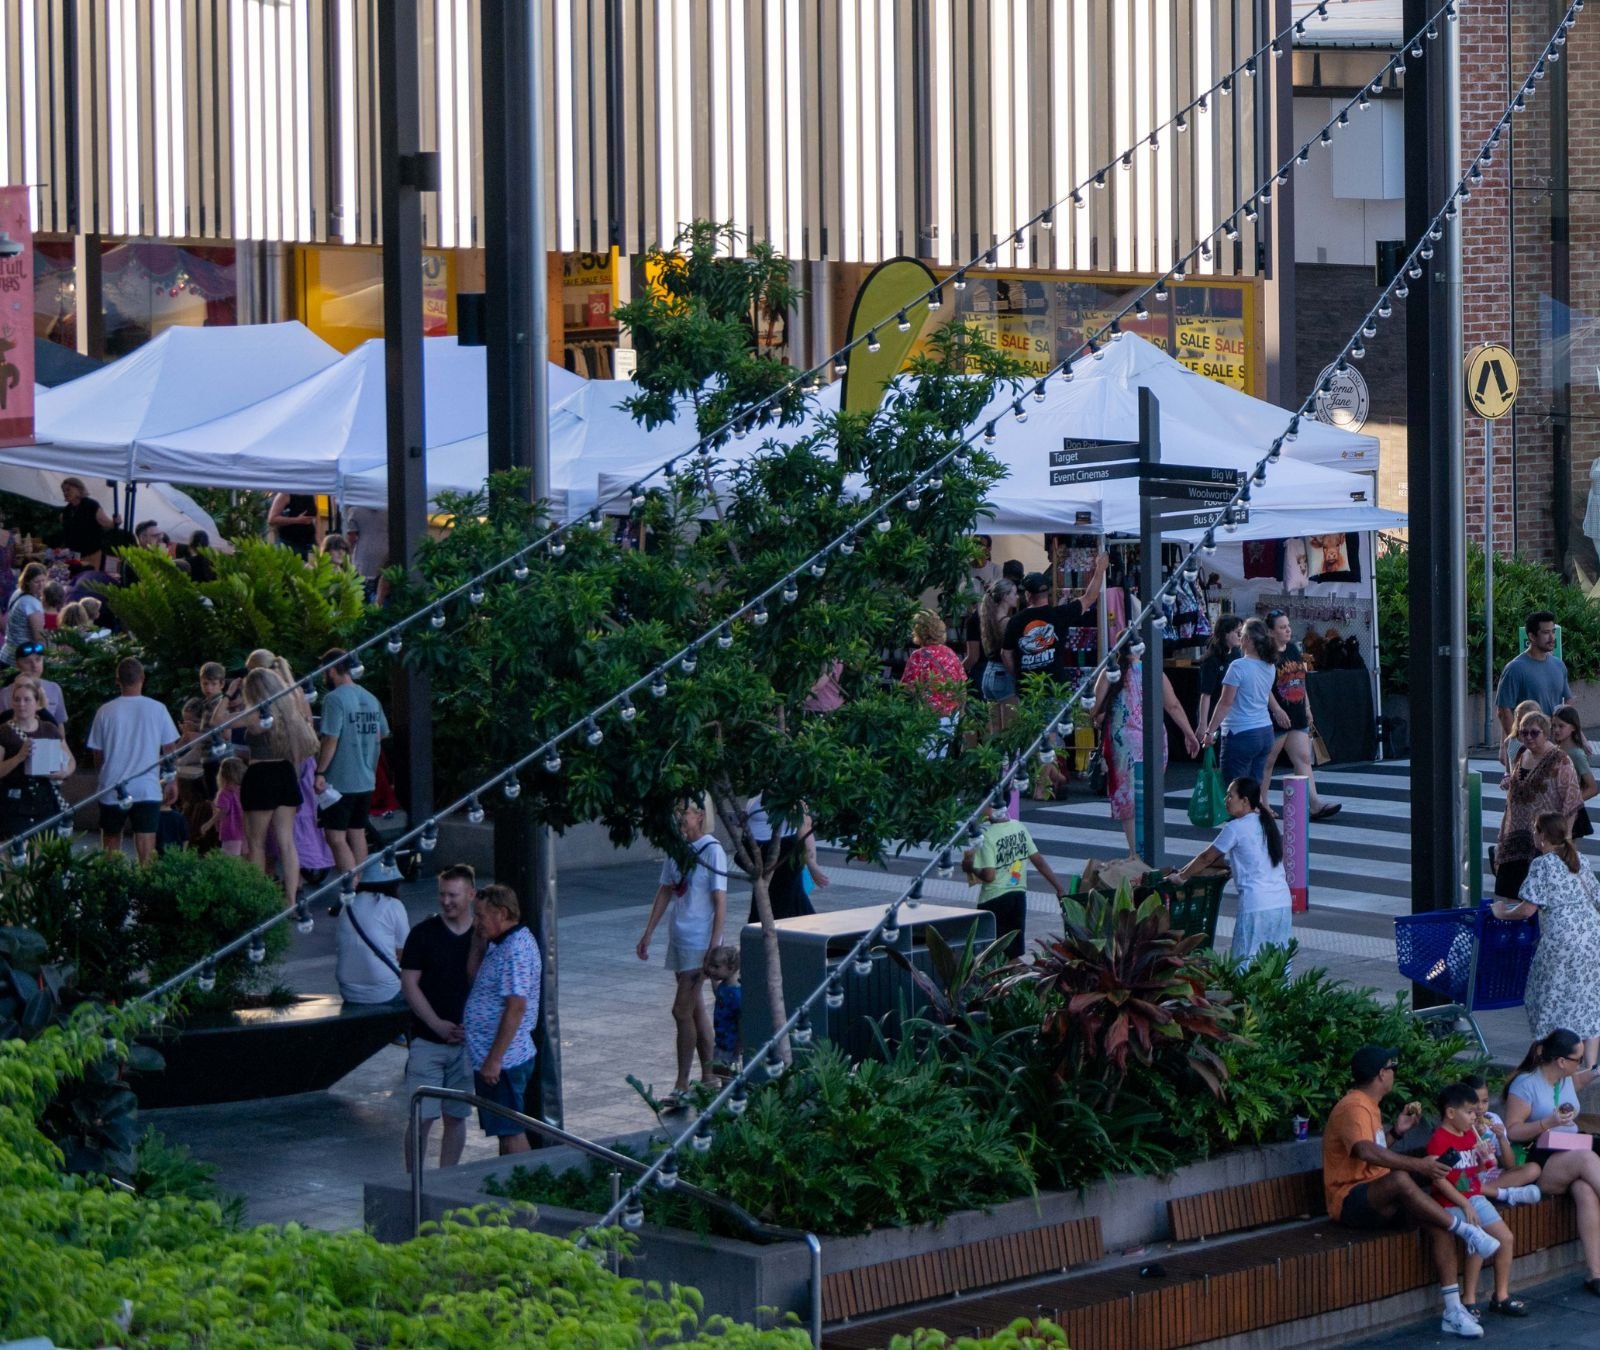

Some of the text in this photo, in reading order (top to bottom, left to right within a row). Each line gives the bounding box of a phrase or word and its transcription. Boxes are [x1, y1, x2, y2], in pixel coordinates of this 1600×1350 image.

[427, 300, 447, 313] SAL
[1001, 334, 1030, 351] SALE
[1035, 339, 1051, 353] SA
[1153, 337, 1169, 351] SA
[1180, 332, 1246, 356] SALE SALE
[1203, 362, 1234, 378] SALE
[1326, 394, 1353, 410] Jane
[1053, 452, 1079, 464] Target
[1053, 470, 1110, 483] Event Cinemas
[1211, 469, 1234, 481] Big W
[1188, 487, 1235, 500] Woolworths
[1193, 515, 1207, 524] Bus
[1208, 514, 1215, 523] &
